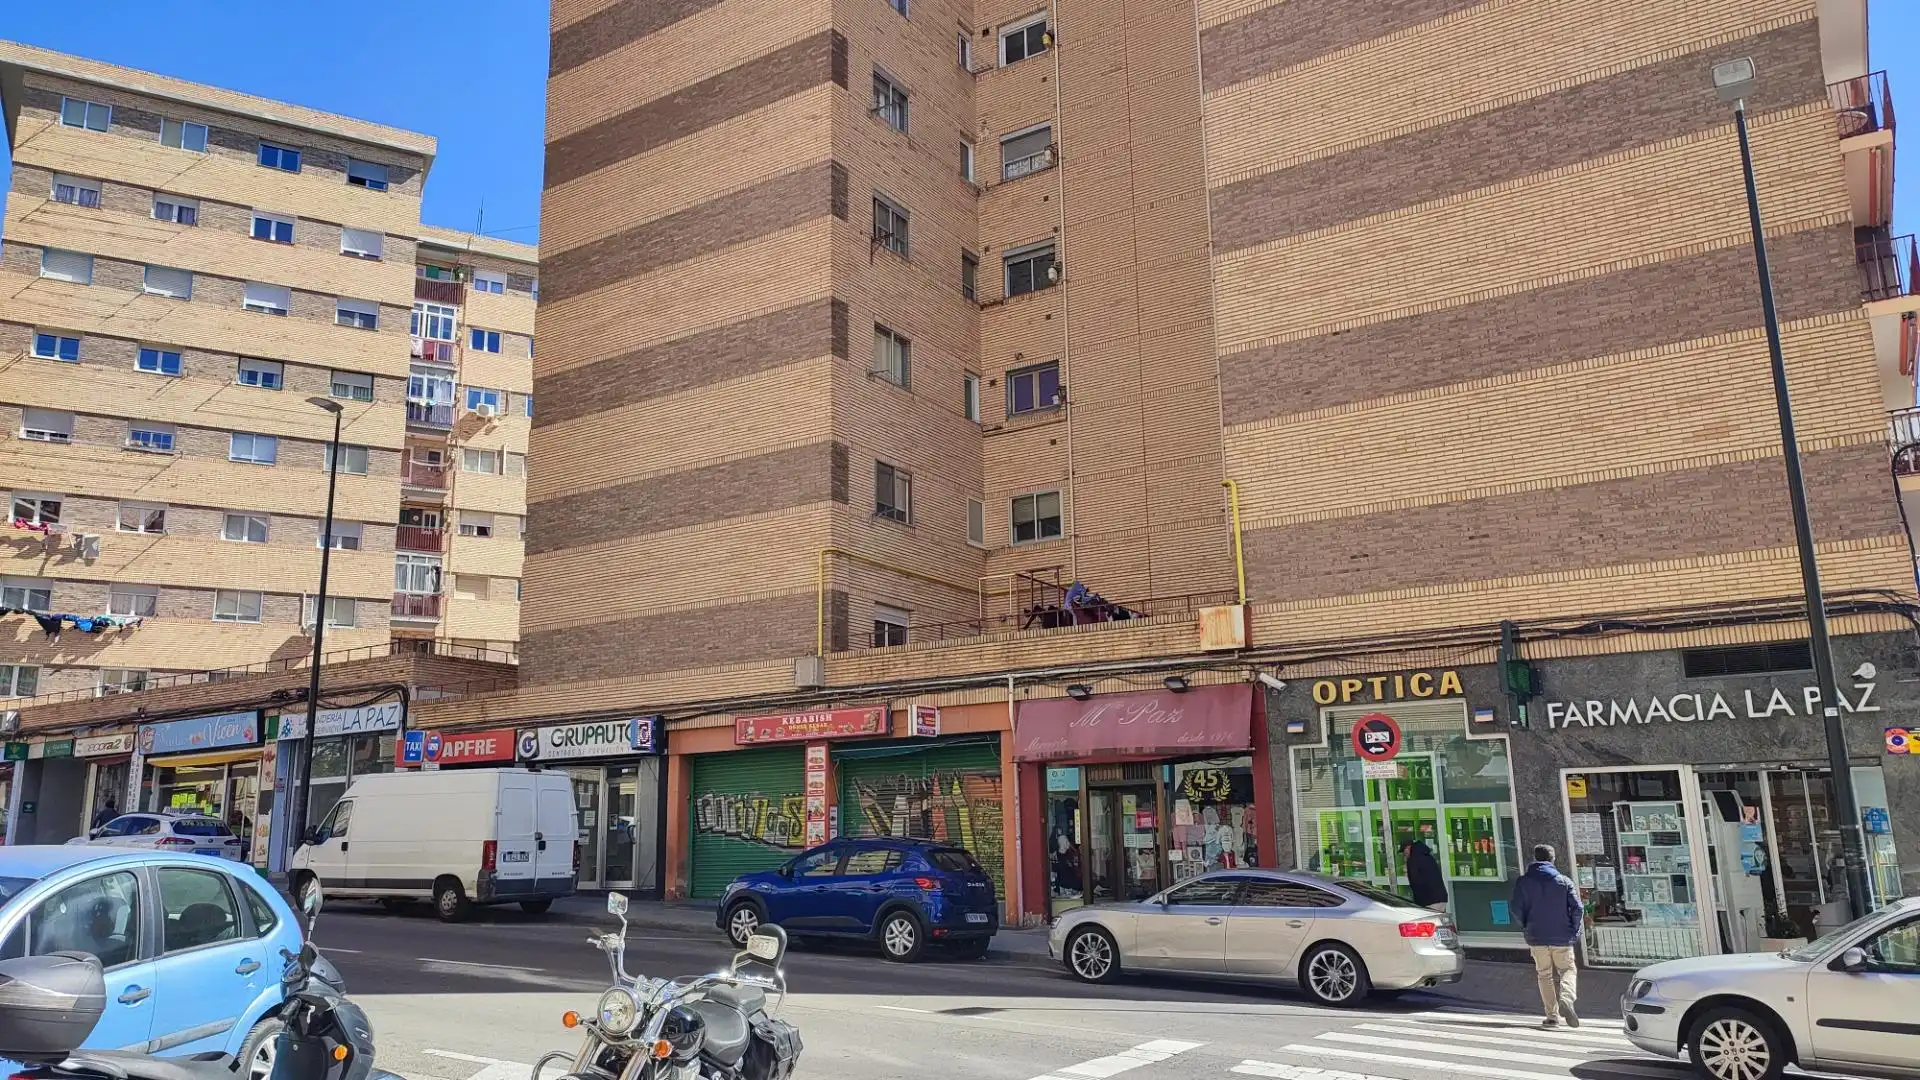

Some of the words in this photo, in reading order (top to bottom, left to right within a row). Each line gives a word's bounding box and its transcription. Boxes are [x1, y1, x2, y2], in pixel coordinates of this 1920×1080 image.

[1312, 670, 1463, 704] OPTICA
[342, 710, 362, 731] LA
[365, 705, 398, 729] PAZ
[782, 713, 833, 726] KEBABISH
[1119, 700, 1184, 726] Paz
[1547, 691, 1736, 729] FARMACIA
[1744, 687, 1796, 720] LA
[442, 738, 497, 758] APFRE
[1193, 769, 1218, 788] 45
